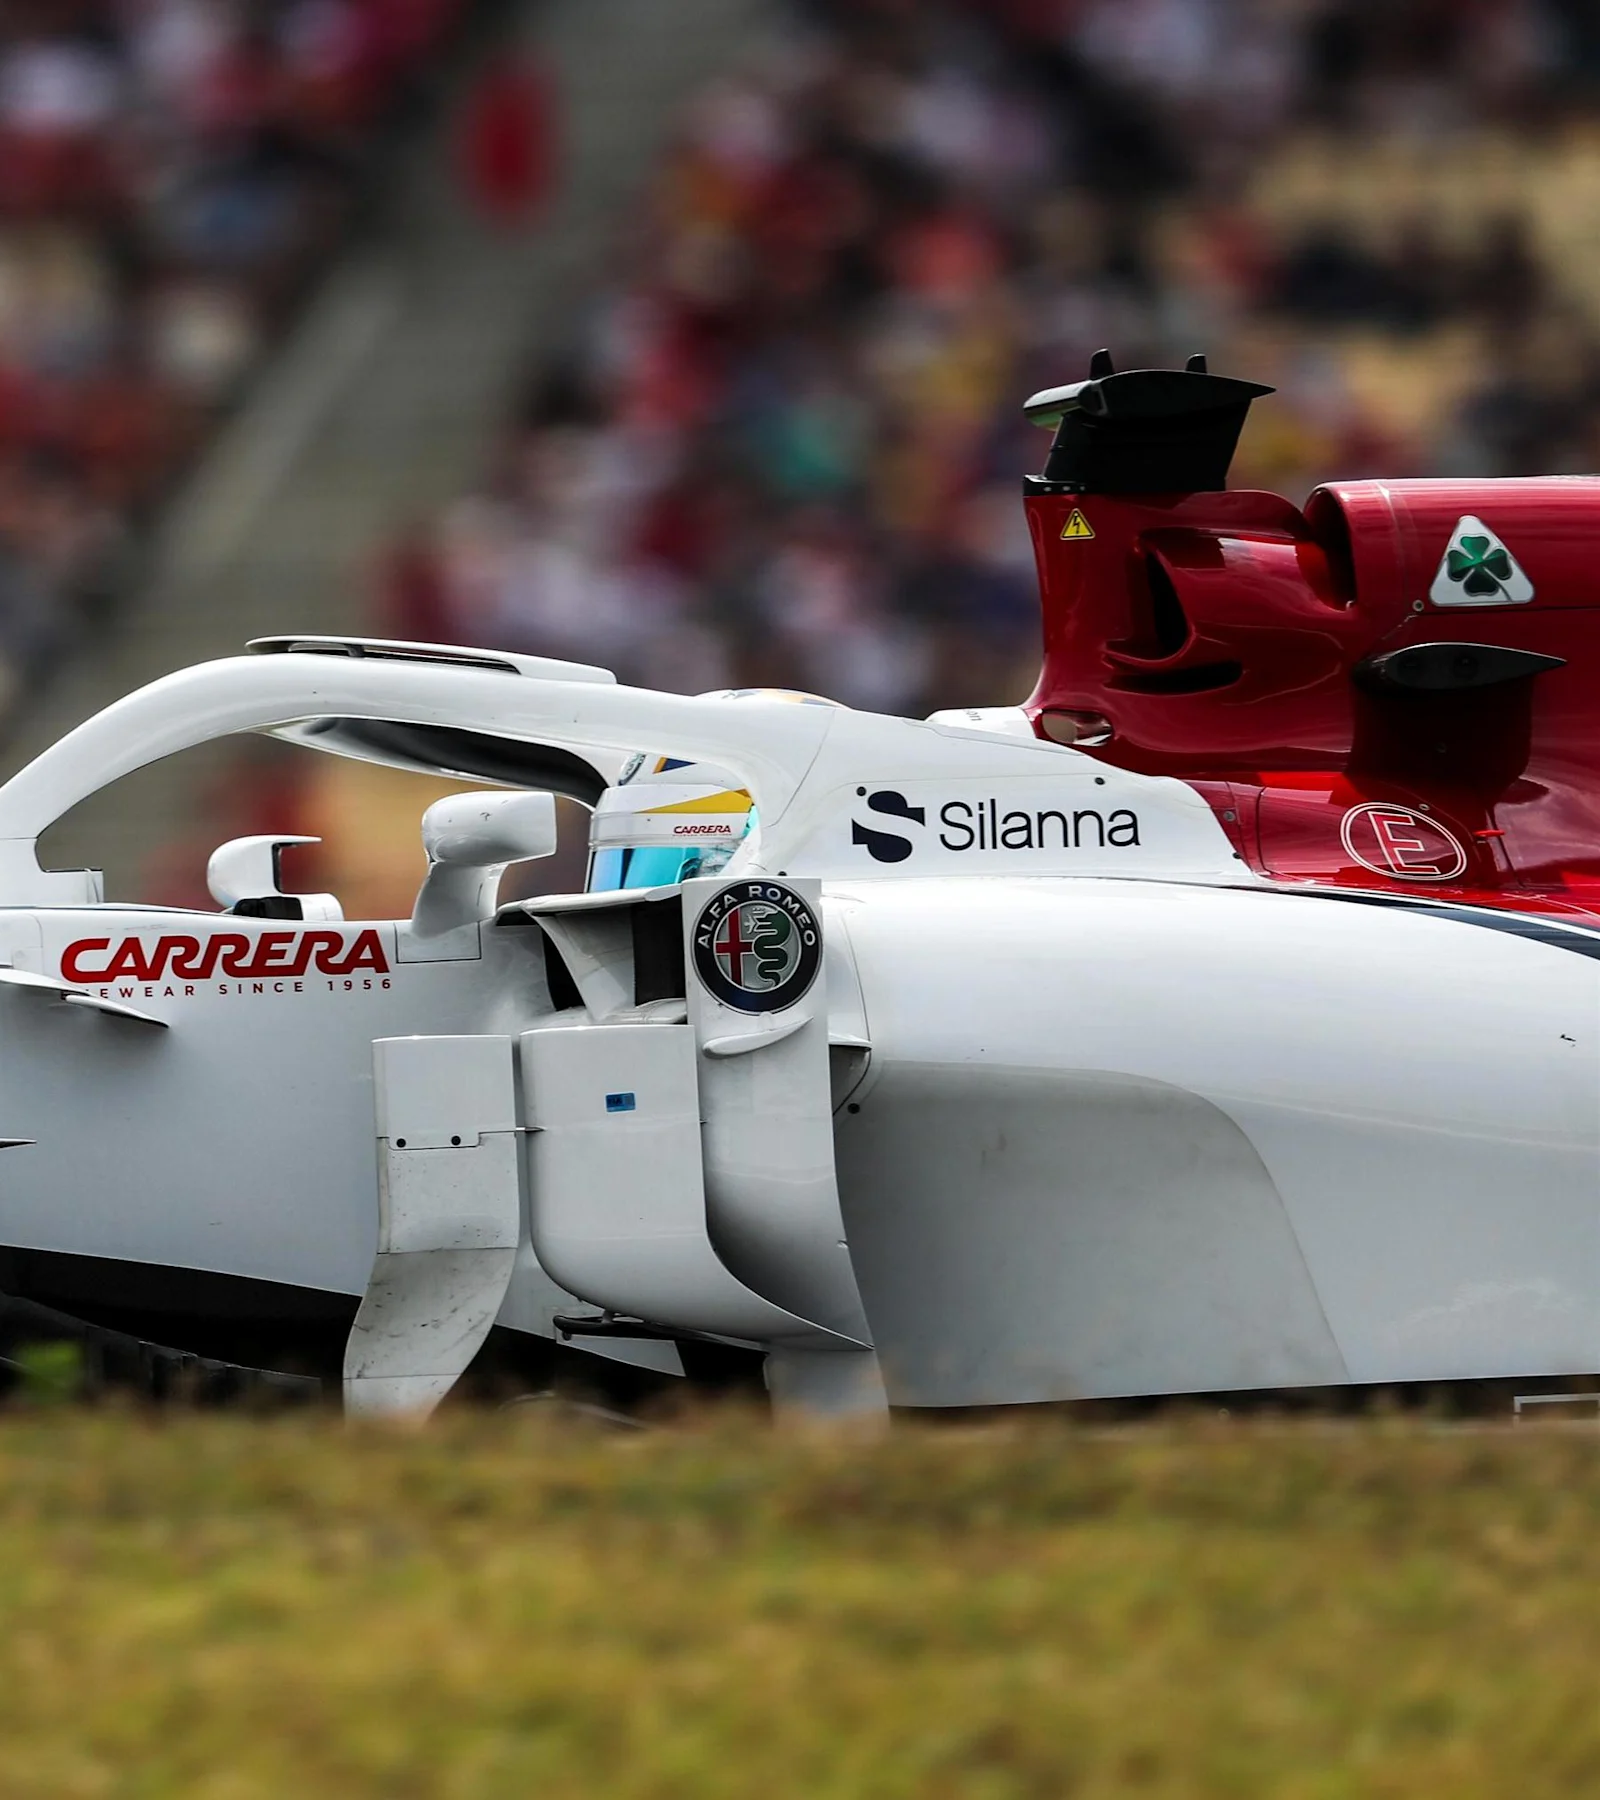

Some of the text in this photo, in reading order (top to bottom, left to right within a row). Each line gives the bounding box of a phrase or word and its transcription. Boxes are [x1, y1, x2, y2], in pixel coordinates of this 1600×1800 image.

[673, 825, 732, 834] CARRERA
[940, 798, 1141, 851] Silanna
[1368, 811, 1441, 874] E
[698, 885, 816, 949] ALFA ROMEO
[60, 929, 390, 982] CARRERA
[219, 981, 304, 995] SINCE
[327, 979, 391, 993] 1956
